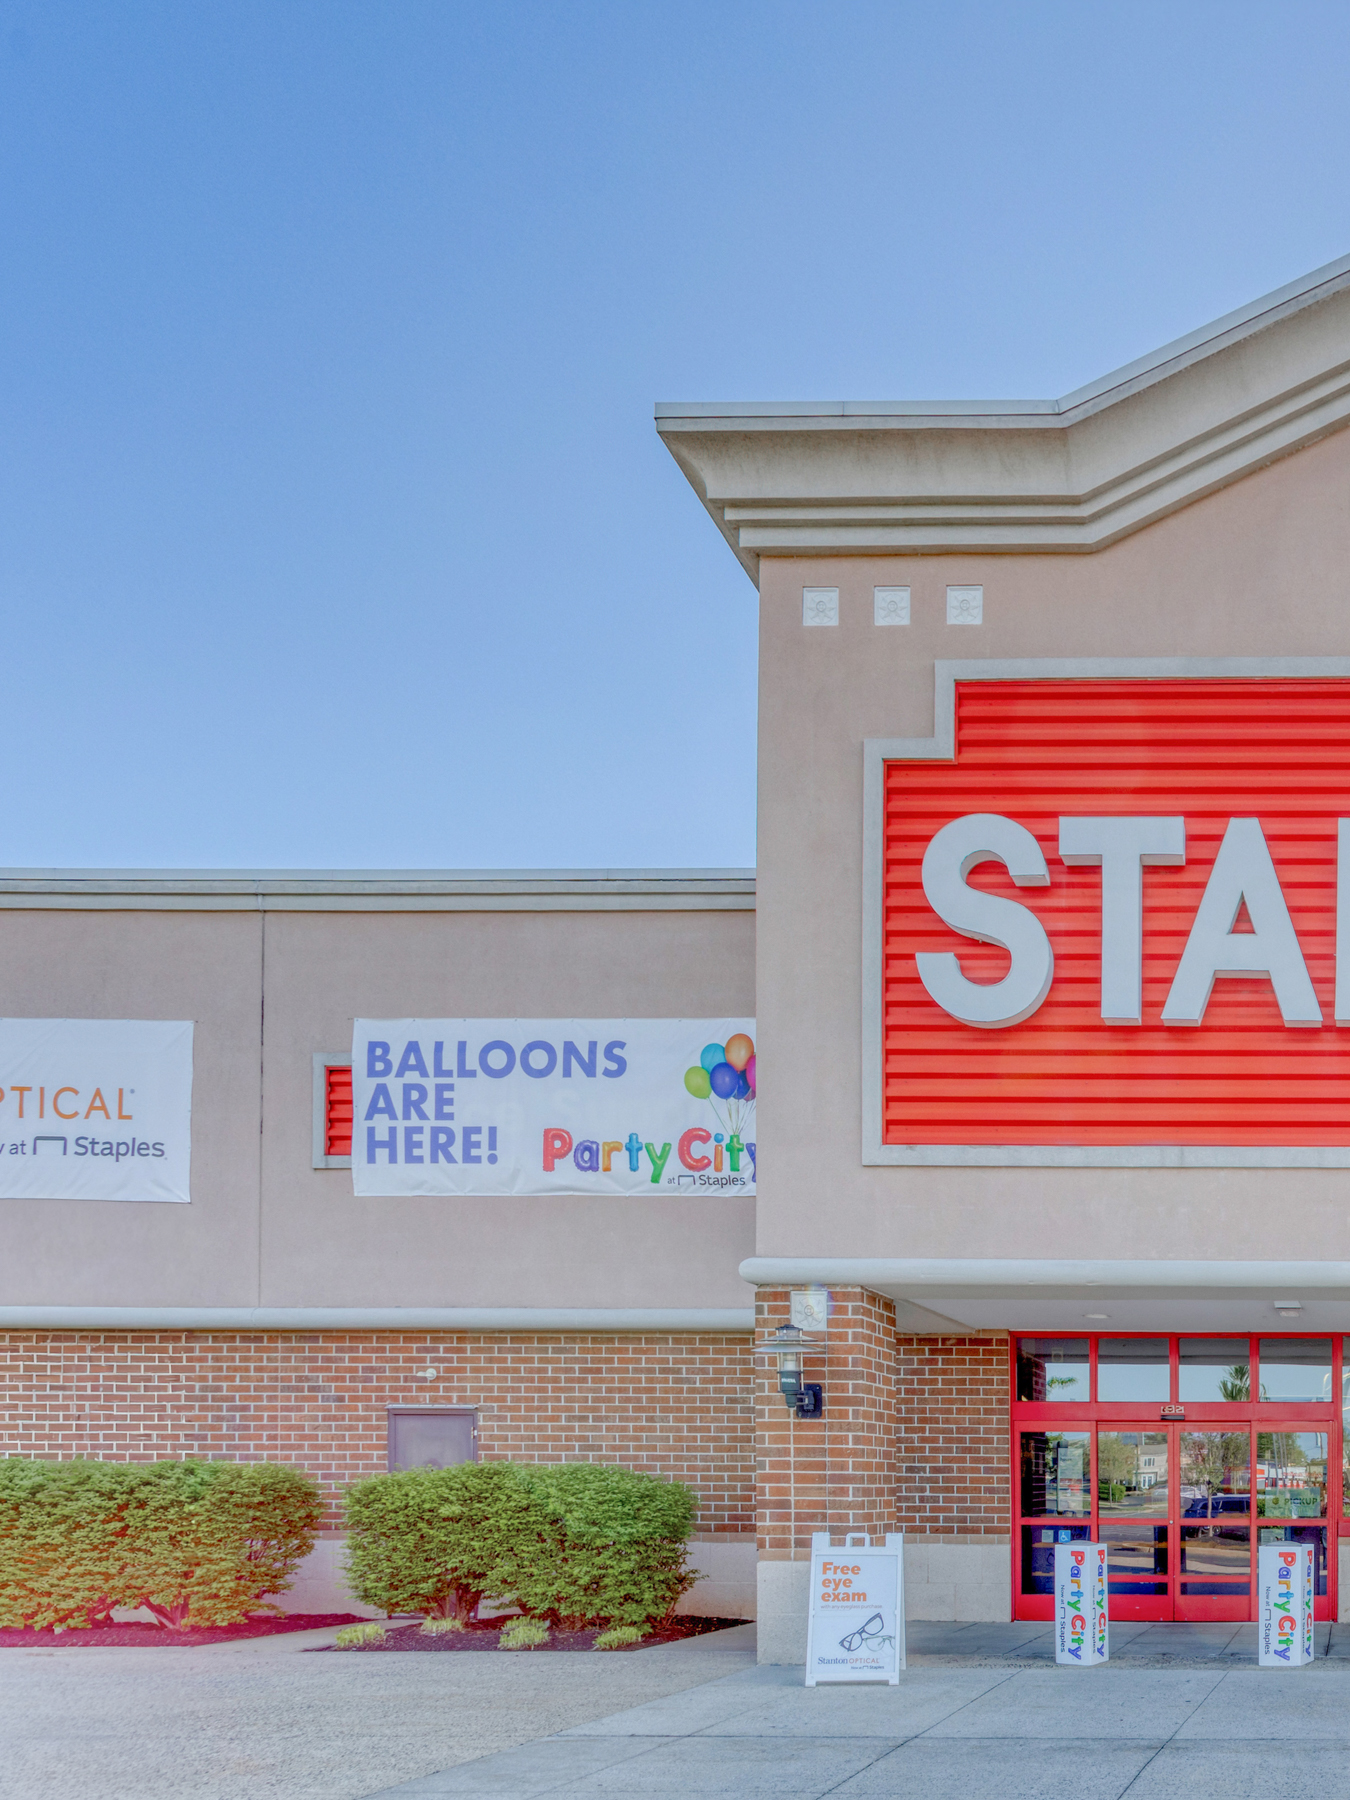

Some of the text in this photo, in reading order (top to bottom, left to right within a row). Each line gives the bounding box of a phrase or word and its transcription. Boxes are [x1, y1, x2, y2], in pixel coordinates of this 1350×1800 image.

[366, 1040, 628, 1079] BALLOONS
[364, 1083, 456, 1121] ARE
[9, 1140, 27, 1155] at
[74, 1136, 166, 1162] Staples
[366, 1126, 499, 1165] HERE!
[542, 1127, 672, 1184] Party
[667, 1174, 746, 1188] at Staples
[1284, 1497, 1318, 1506] PICKUP
[821, 1578, 853, 1592] eye
[822, 1562, 861, 1576] Free
[1067, 1550, 1085, 1612] Party
[821, 1592, 867, 1602] exam
[1274, 1552, 1296, 1661] Party City
[1068, 1614, 1086, 1660] City
[1263, 1622, 1271, 1655] Staples
[817, 1656, 848, 1665] Stanton
